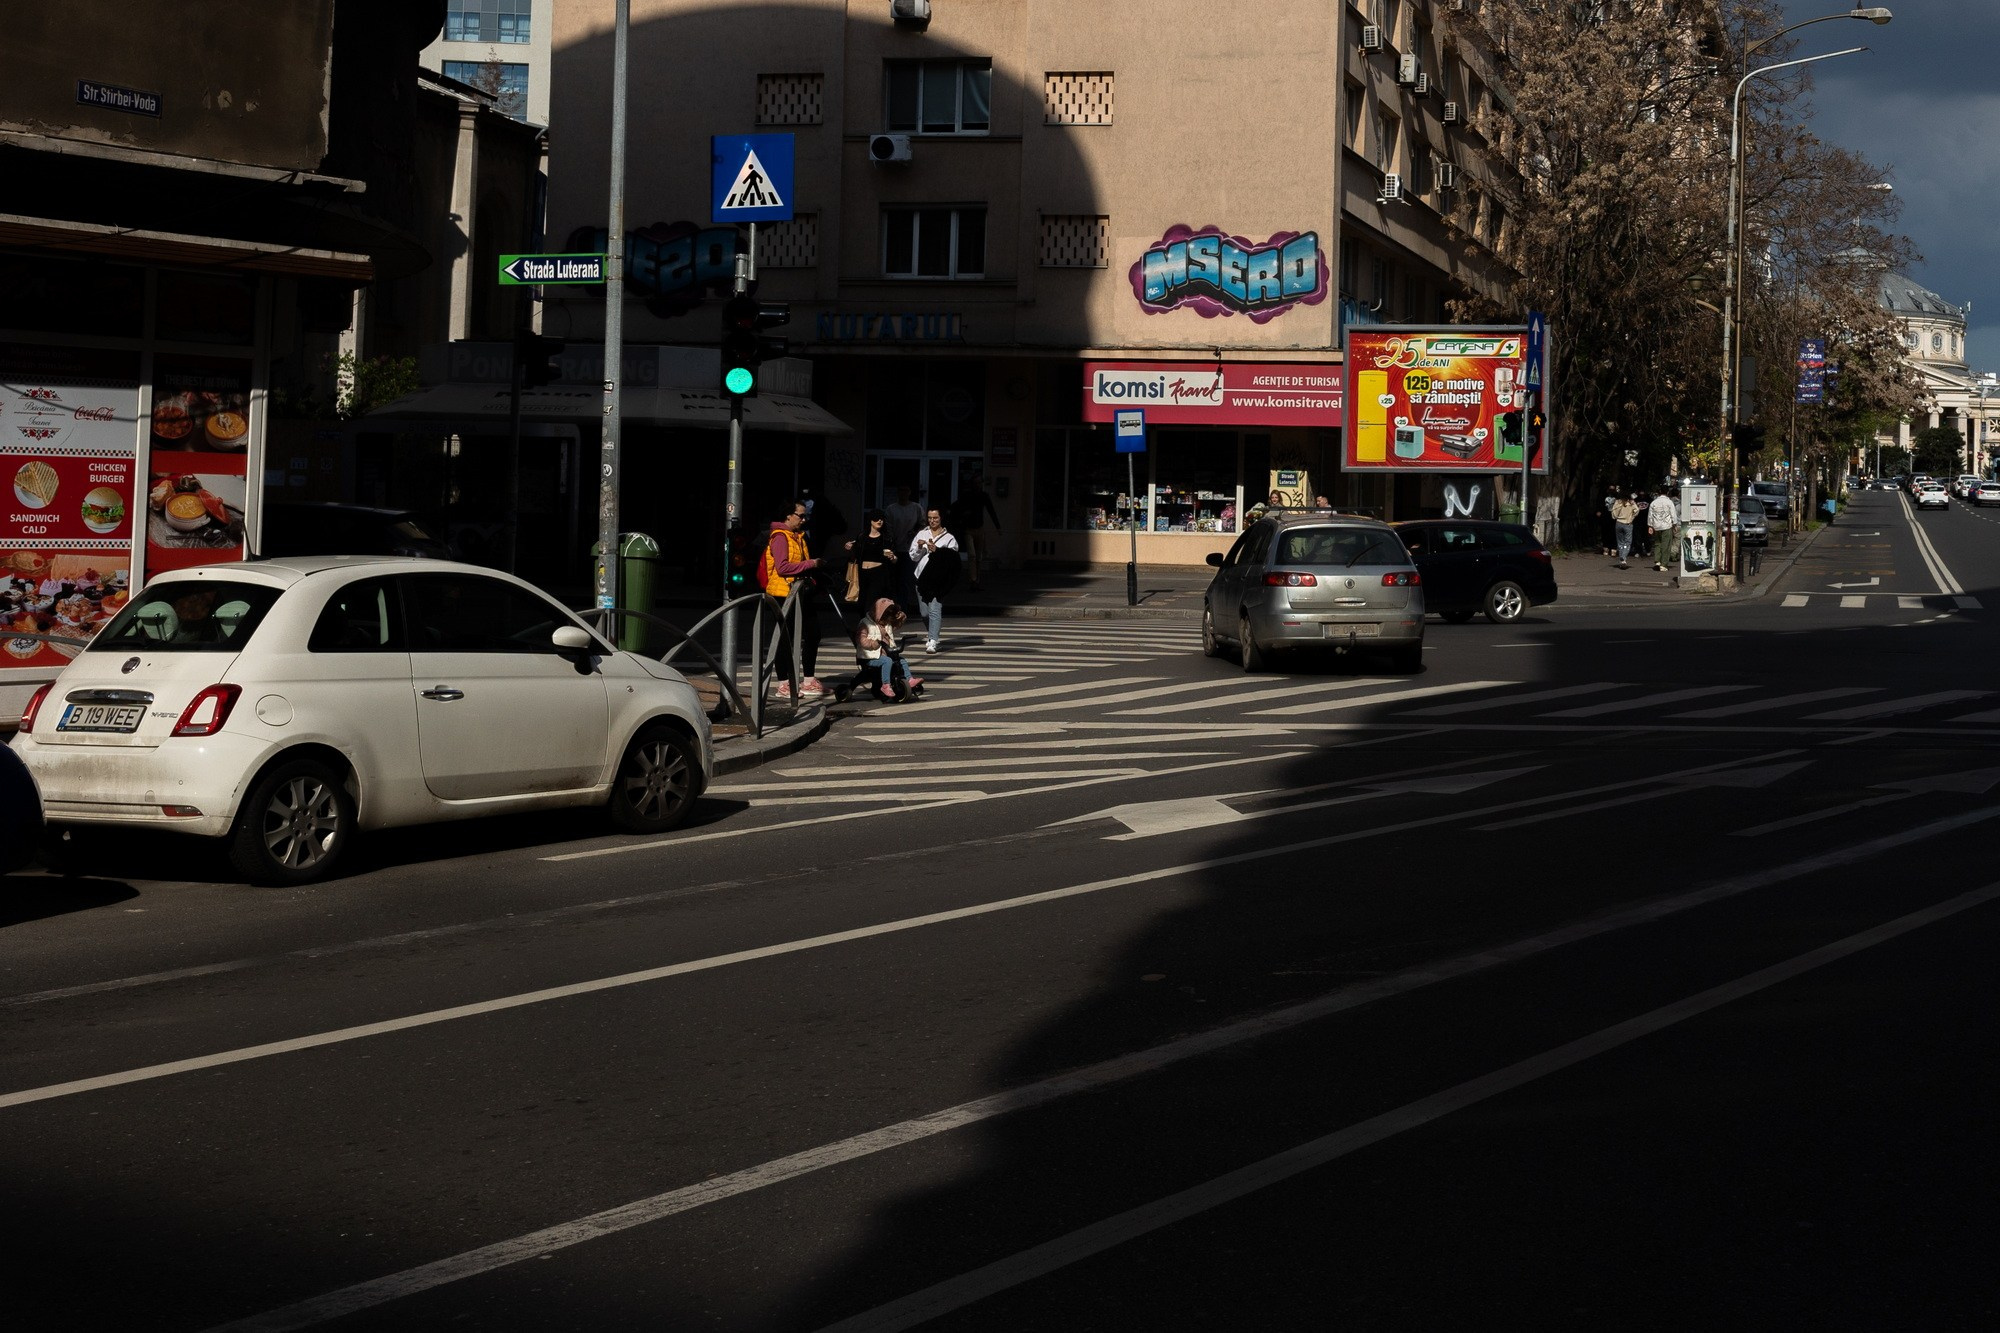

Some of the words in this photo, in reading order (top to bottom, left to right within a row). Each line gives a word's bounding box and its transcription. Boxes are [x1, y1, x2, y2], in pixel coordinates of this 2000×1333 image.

[84, 84, 99, 101] Str.
[523, 260, 555, 279] Strada
[557, 259, 600, 278] Luterană
[1374, 337, 1422, 368] 25
[1435, 342, 1495, 354] CATENA
[1419, 359, 1432, 367] de
[1433, 358, 1450, 367] ANI
[1098, 373, 1165, 398] komsi
[1169, 377, 1222, 405] travel
[1292, 377, 1304, 386] DE
[1305, 377, 1340, 387] TURISM
[1405, 375, 1430, 390] 125
[1431, 379, 1444, 390] de
[1446, 378, 1485, 390] motive
[1409, 392, 1423, 404] să
[1424, 391, 1482, 407] zâmbești!
[88, 463, 127, 473] CHICKEN
[89, 474, 125, 484] BURGER
[10, 513, 60, 523] SANDWICH
[22, 525, 47, 534] CALD
[69, 707, 83, 724] B
[84, 708, 104, 724] 119
[104, 708, 139, 726] WEE
